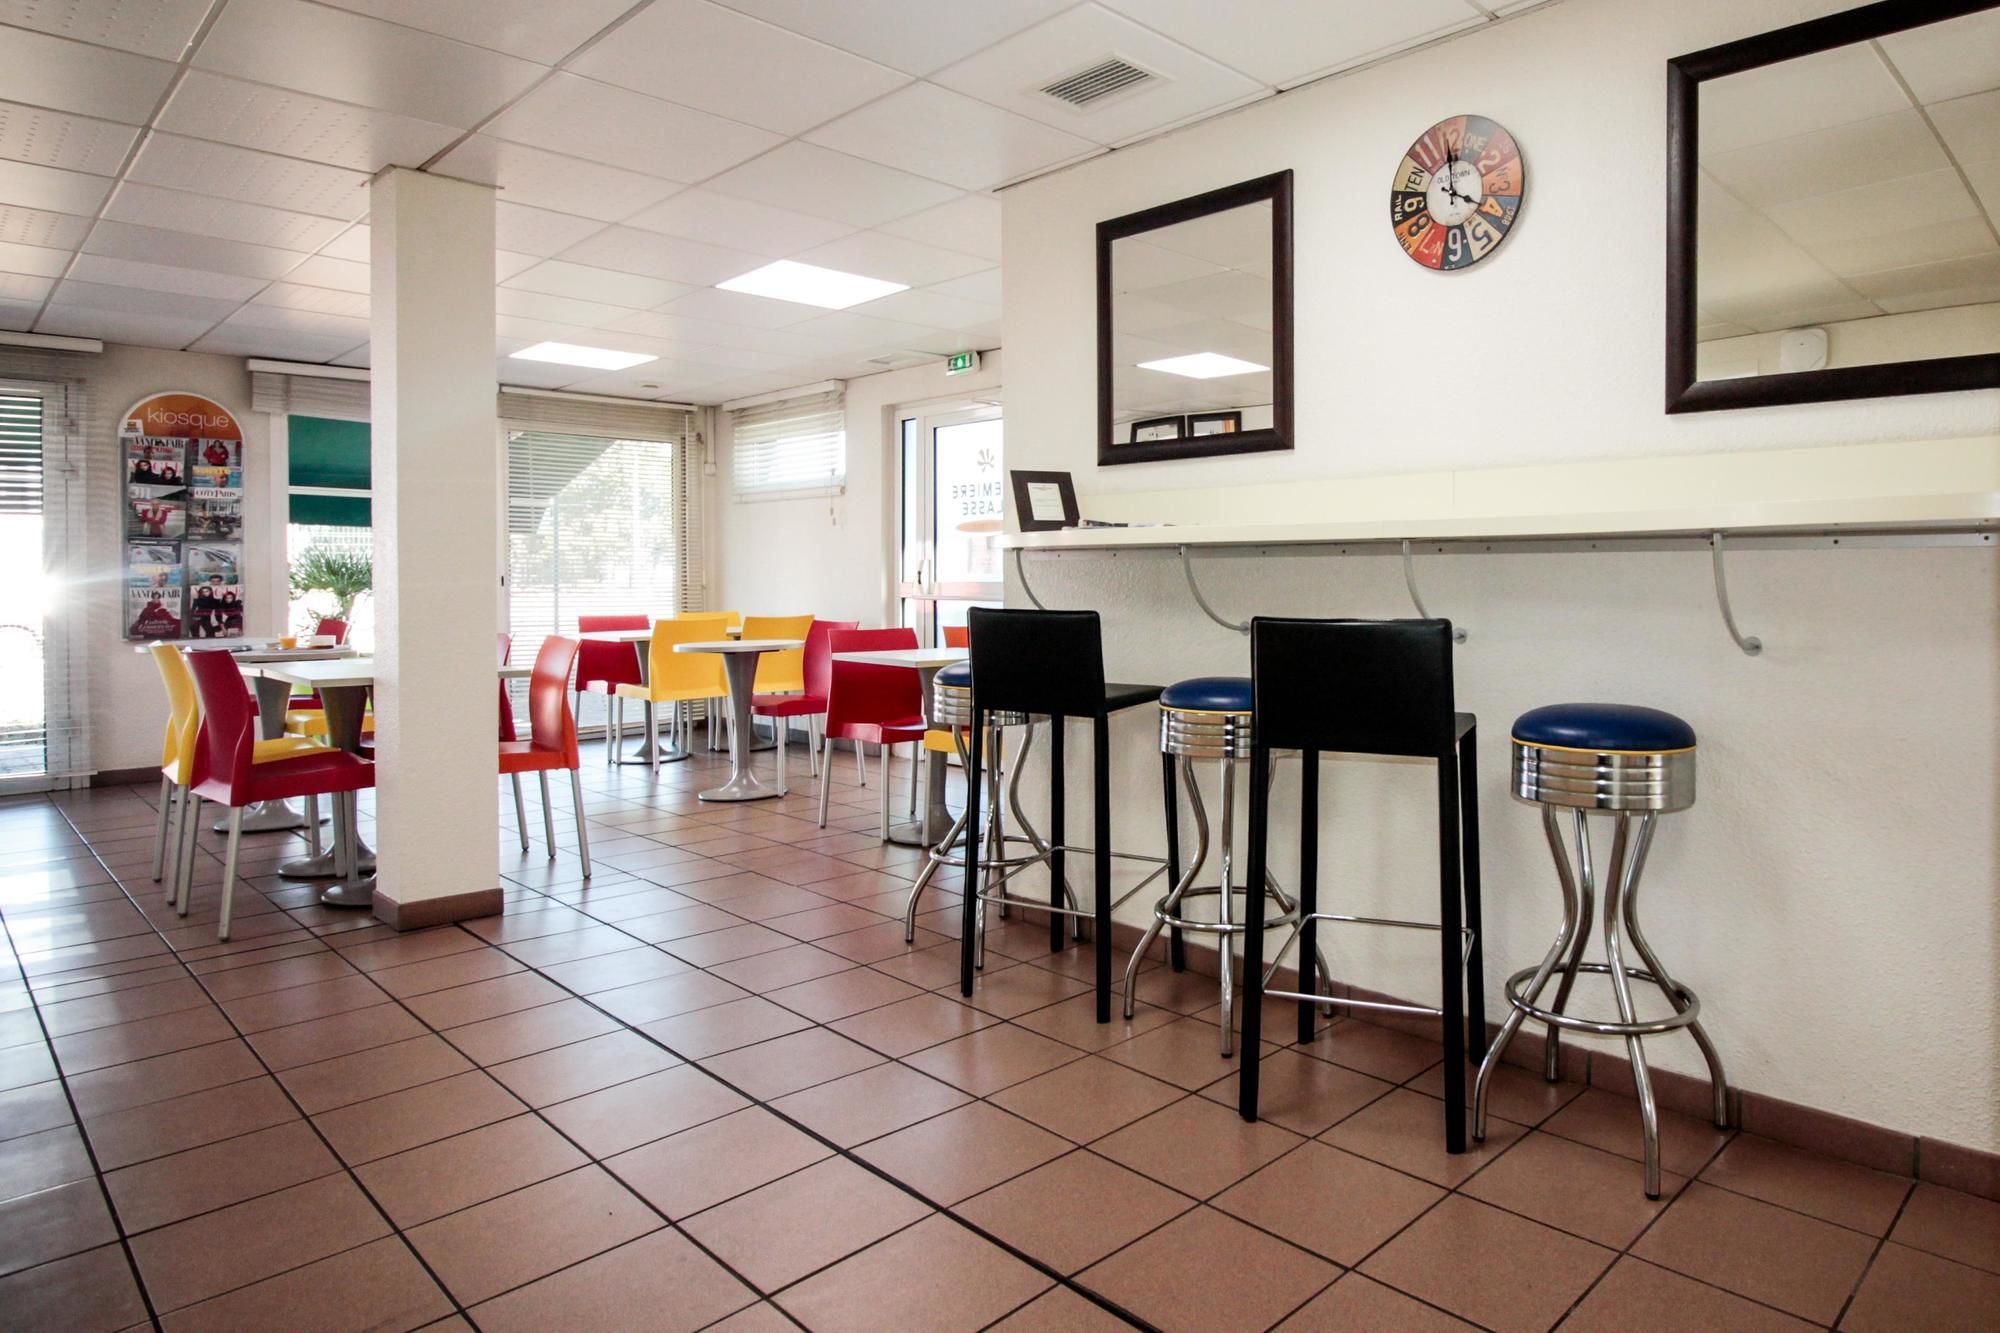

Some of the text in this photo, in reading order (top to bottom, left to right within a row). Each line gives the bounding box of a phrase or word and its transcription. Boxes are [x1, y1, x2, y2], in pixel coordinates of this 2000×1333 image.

[1404, 166, 1425, 192] TEN
[1394, 194, 1403, 221] RAIL
[1408, 213, 1430, 237] 8
[1472, 221, 1494, 251] 5
[147, 406, 229, 430] kiosque
